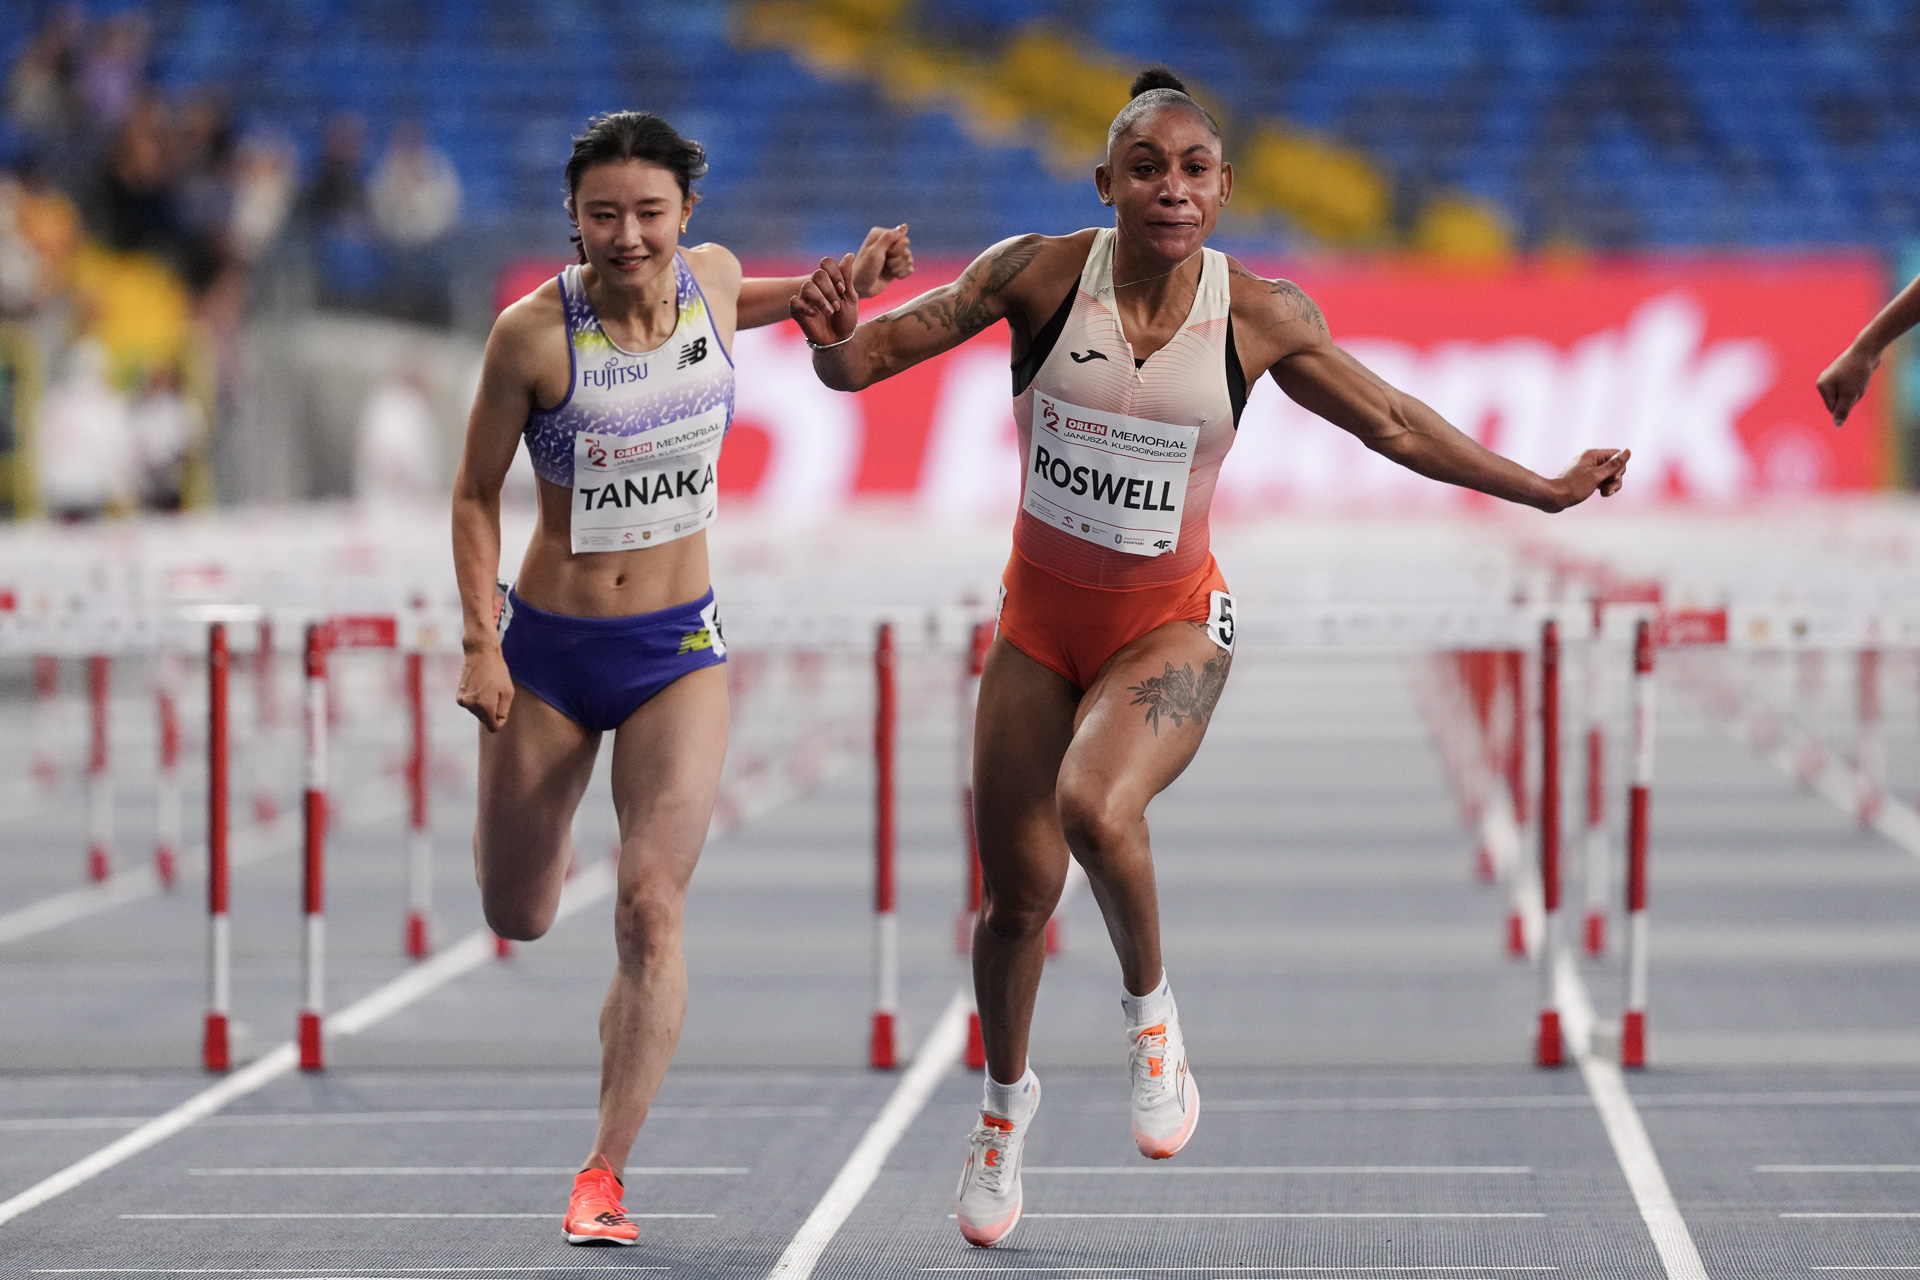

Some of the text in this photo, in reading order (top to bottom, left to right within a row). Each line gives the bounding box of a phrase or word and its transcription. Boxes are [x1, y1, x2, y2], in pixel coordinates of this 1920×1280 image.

[583, 358, 648, 391] FUJITSU
[615, 423, 721, 458] ORLEN MEMORIAŁ
[1064, 432, 1187, 458] JANUSZA KUSOCIŃSKIEGO
[1067, 420, 1188, 449] ORLEN MEMORIAŁ
[613, 454, 656, 467] JANUSZA
[579, 464, 714, 511] TANAKA
[1034, 445, 1175, 512] ROSWELL
[1153, 539, 1172, 550] 4F
[1219, 597, 1235, 645] 5
